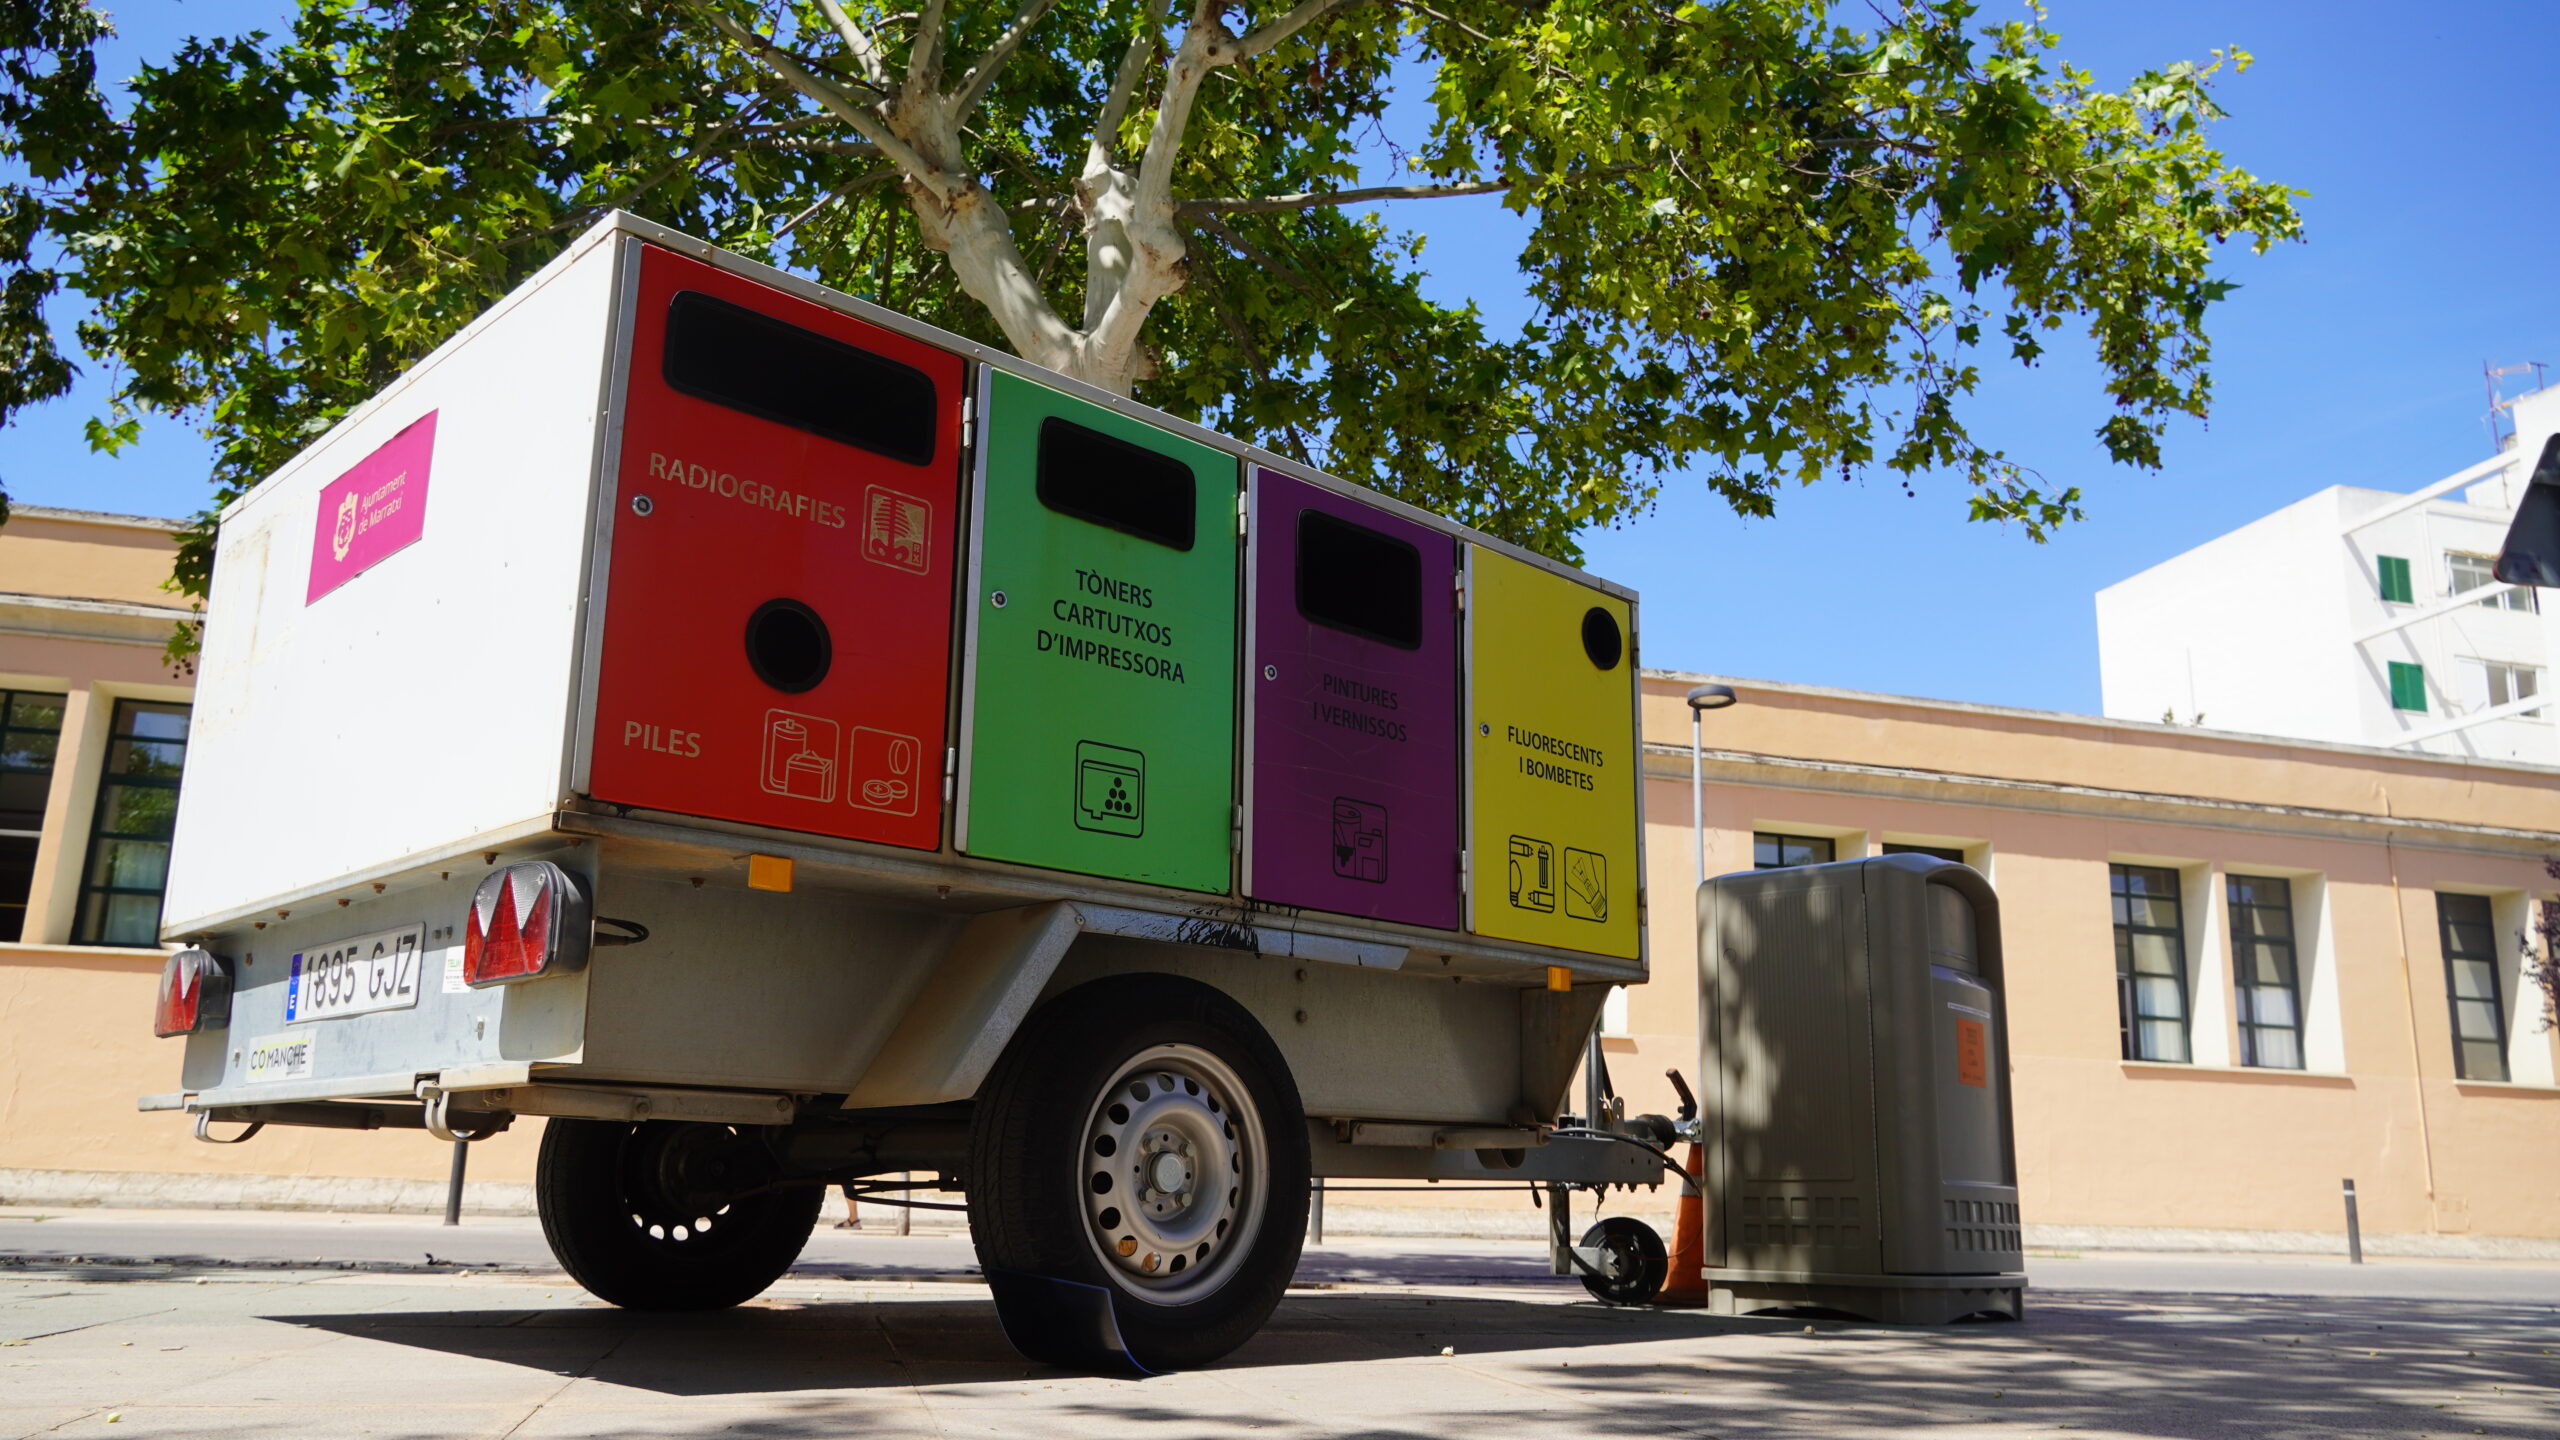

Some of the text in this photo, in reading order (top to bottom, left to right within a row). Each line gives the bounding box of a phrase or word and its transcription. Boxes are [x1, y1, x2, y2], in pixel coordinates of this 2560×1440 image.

[360, 469, 407, 514] Ajuntament
[648, 452, 846, 529] RADIOGRAFIES
[358, 490, 404, 535] de Marratxí
[1075, 569, 1153, 609] TÒNERS
[1053, 599, 1172, 647] CARTUTXOS
[1037, 629, 1185, 684] D'IMPRESSORA
[1323, 673, 1399, 710] PINTURES
[624, 720, 702, 758] PILES
[1313, 702, 1408, 742] I VERNISSOS
[1508, 725, 1604, 768] FLUORESCENTS
[1519, 757, 1594, 791] I BOMBETES
[304, 946, 358, 1011] 1895
[368, 933, 417, 999] GJZ
[250, 1044, 308, 1070] COMANCHE
